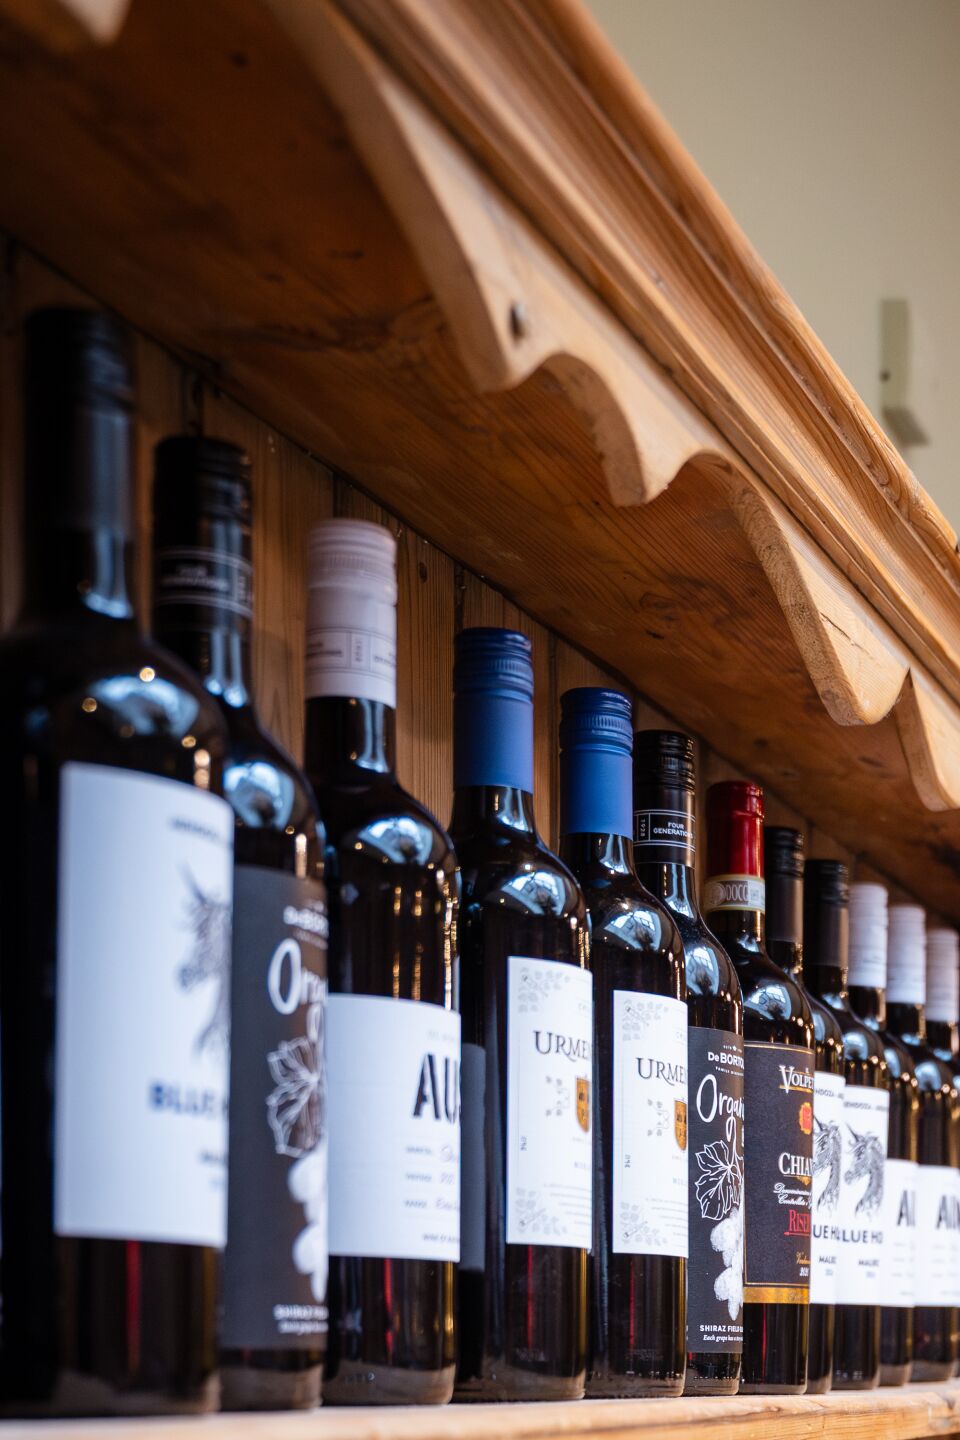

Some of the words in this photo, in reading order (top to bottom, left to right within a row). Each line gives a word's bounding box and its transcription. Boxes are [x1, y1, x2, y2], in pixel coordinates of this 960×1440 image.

[667, 821, 684, 830] FOUR
[533, 1030, 592, 1063] URME
[636, 1057, 688, 1087] URME
[412, 1052, 461, 1124] AU
[699, 1324, 727, 1332] SHIRAZ
